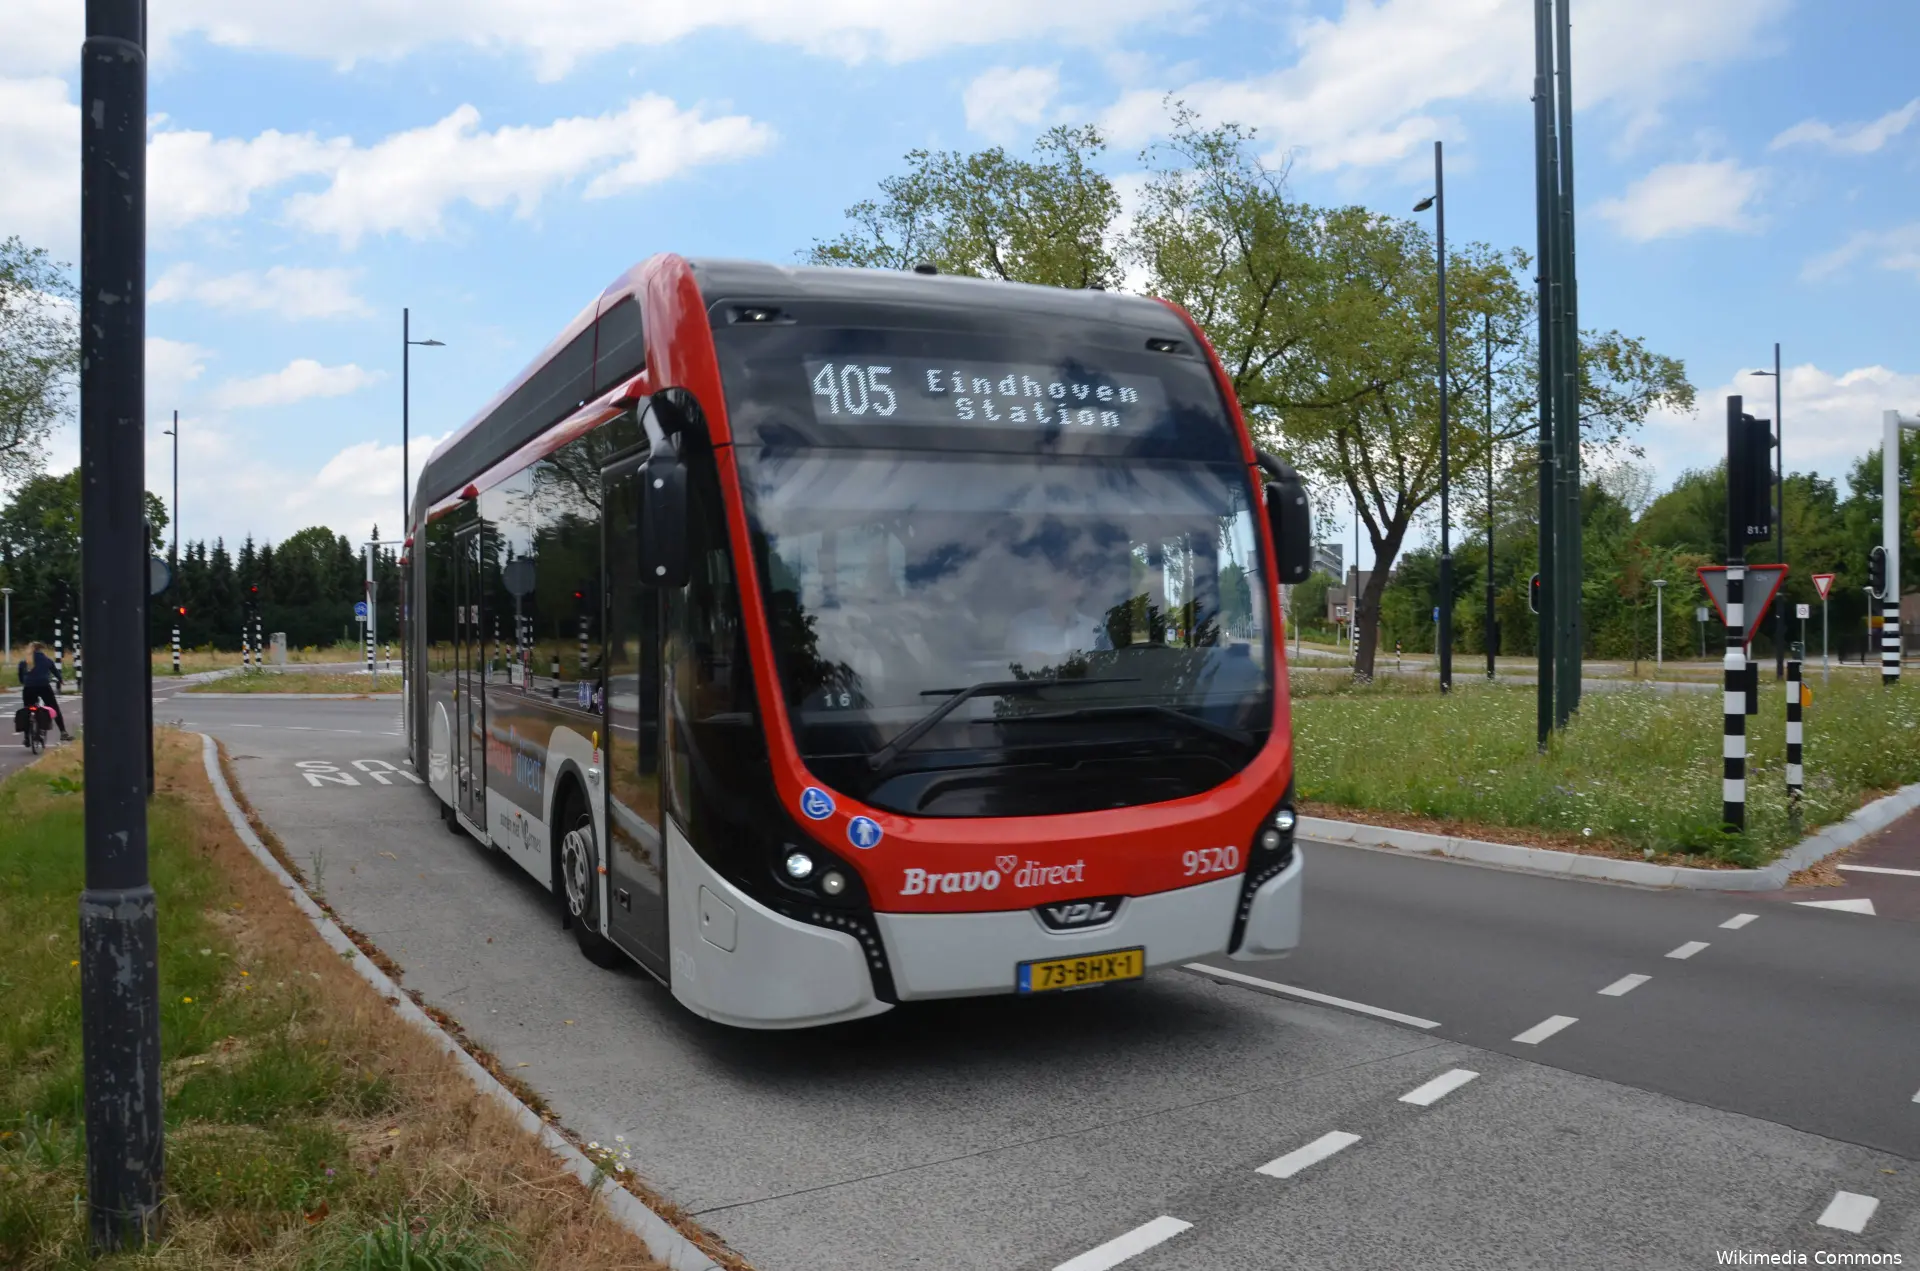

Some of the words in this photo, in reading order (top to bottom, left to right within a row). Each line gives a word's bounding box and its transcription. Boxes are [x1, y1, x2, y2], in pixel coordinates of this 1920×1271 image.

[813, 363, 897, 417] 405
[925, 369, 1138, 403] Eindhoven
[955, 397, 1120, 427] Station
[295, 759, 413, 773] US
[900, 867, 1001, 895] Bravo
[1014, 858, 1085, 889] direct
[1182, 845, 1239, 877] 9520
[1046, 901, 1113, 925] VDL
[1040, 955, 1132, 985] 73-BHX-1
